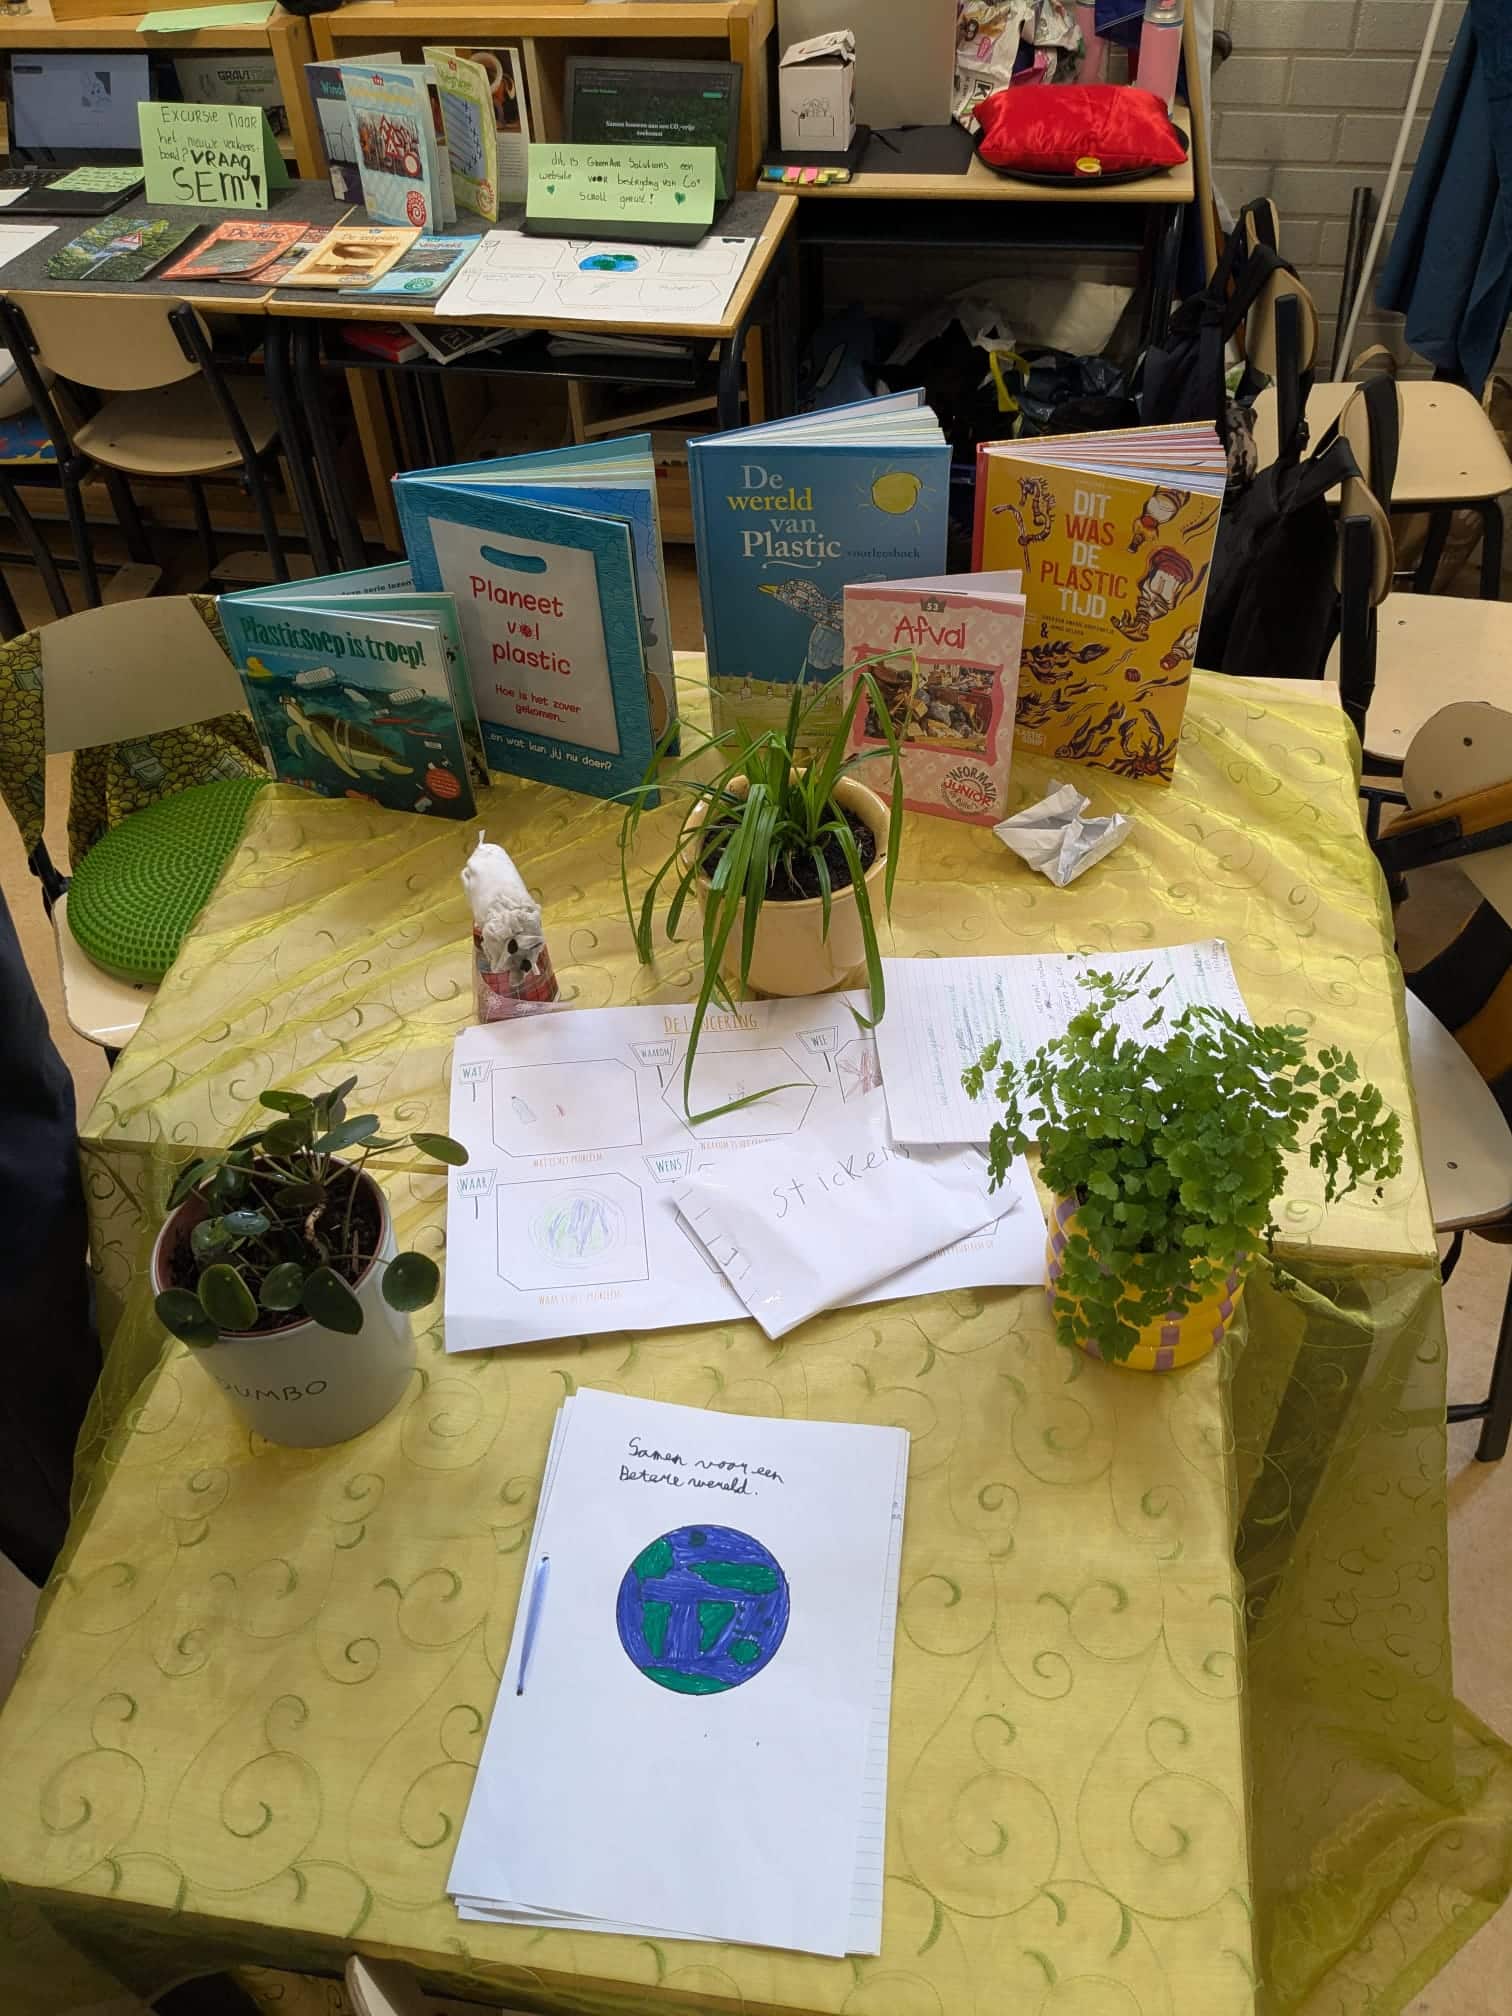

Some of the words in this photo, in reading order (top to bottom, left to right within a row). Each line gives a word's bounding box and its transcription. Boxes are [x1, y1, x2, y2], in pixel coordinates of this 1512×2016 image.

[740, 465, 784, 490] De
[726, 487, 814, 512] wereld
[1074, 489, 1112, 519] DIT
[769, 518, 817, 534] van
[1065, 513, 1116, 546] WAS
[740, 530, 841, 559] Plastic
[1071, 541, 1103, 569] DE
[1040, 559, 1129, 599] PLASTIC
[469, 575, 565, 618] Planeet
[1057, 588, 1108, 619] TIJD
[893, 615, 966, 650] Afval
[348, 631, 366, 659] is
[365, 634, 427, 671] troep!
[492, 641, 572, 676] plastic
[495, 684, 515, 698] Hoe
[519, 689, 528, 701] is
[531, 691, 549, 707] het
[553, 700, 581, 715] zover
[505, 738, 525, 749] wat
[528, 741, 546, 754] kun
[565, 752, 578, 762] nu
[810, 1034, 830, 1048] WIE
[462, 1066, 482, 1079] WAT
[655, 1158, 682, 1174] WENS
[459, 1177, 488, 1191] WAAR
[628, 1436, 687, 1466] Samen
